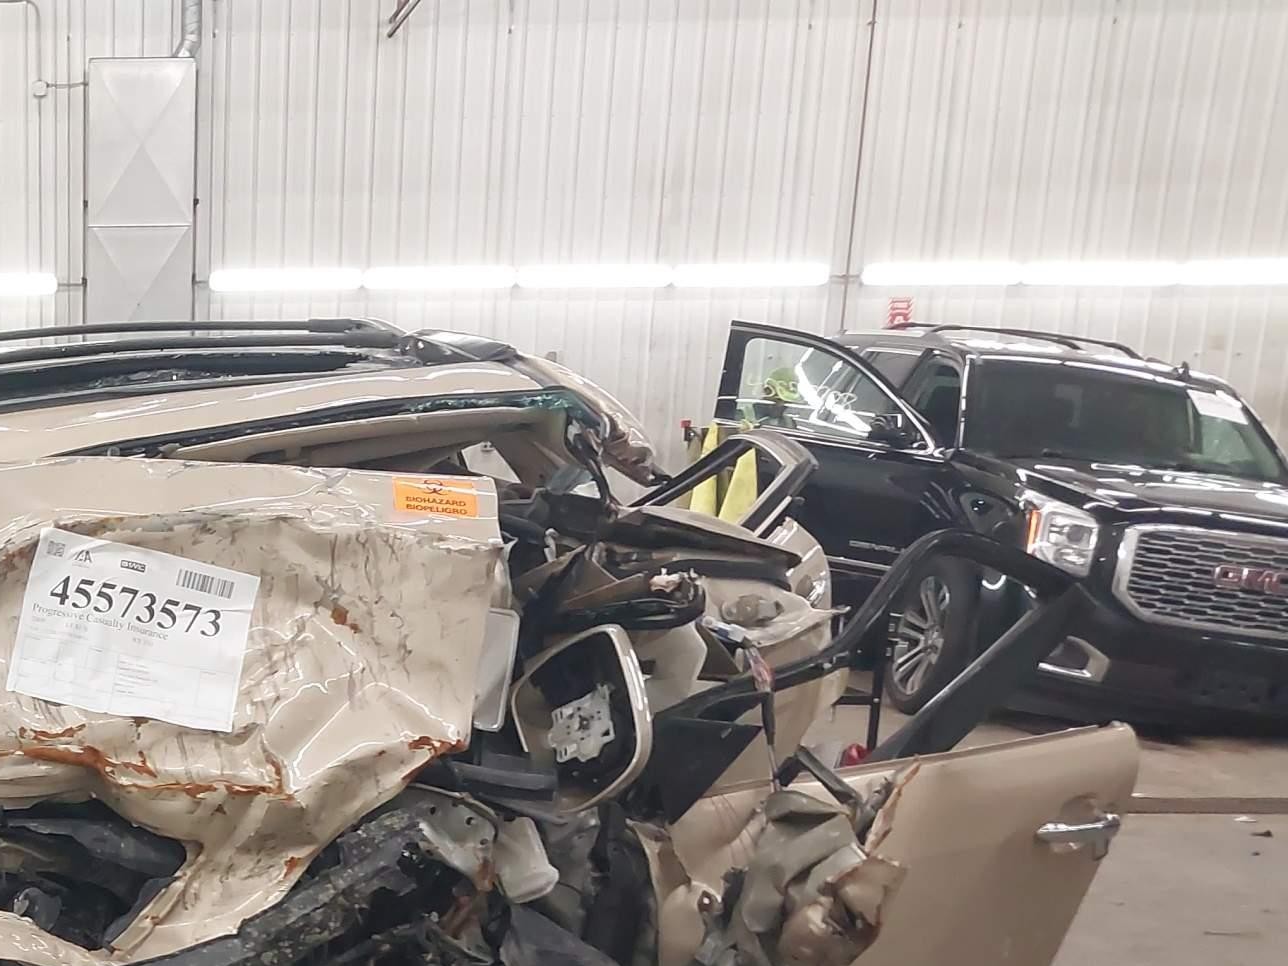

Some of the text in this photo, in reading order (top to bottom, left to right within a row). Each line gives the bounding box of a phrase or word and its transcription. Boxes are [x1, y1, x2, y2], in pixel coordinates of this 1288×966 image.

[405, 496, 466, 507] BIOHAZARD
[406, 503, 468, 515] BIOPELIGRO
[50, 575, 222, 637] 45573573
[32, 603, 85, 621] Progressive
[86, 614, 125, 631] Casualty
[127, 622, 169, 641] Insurance
